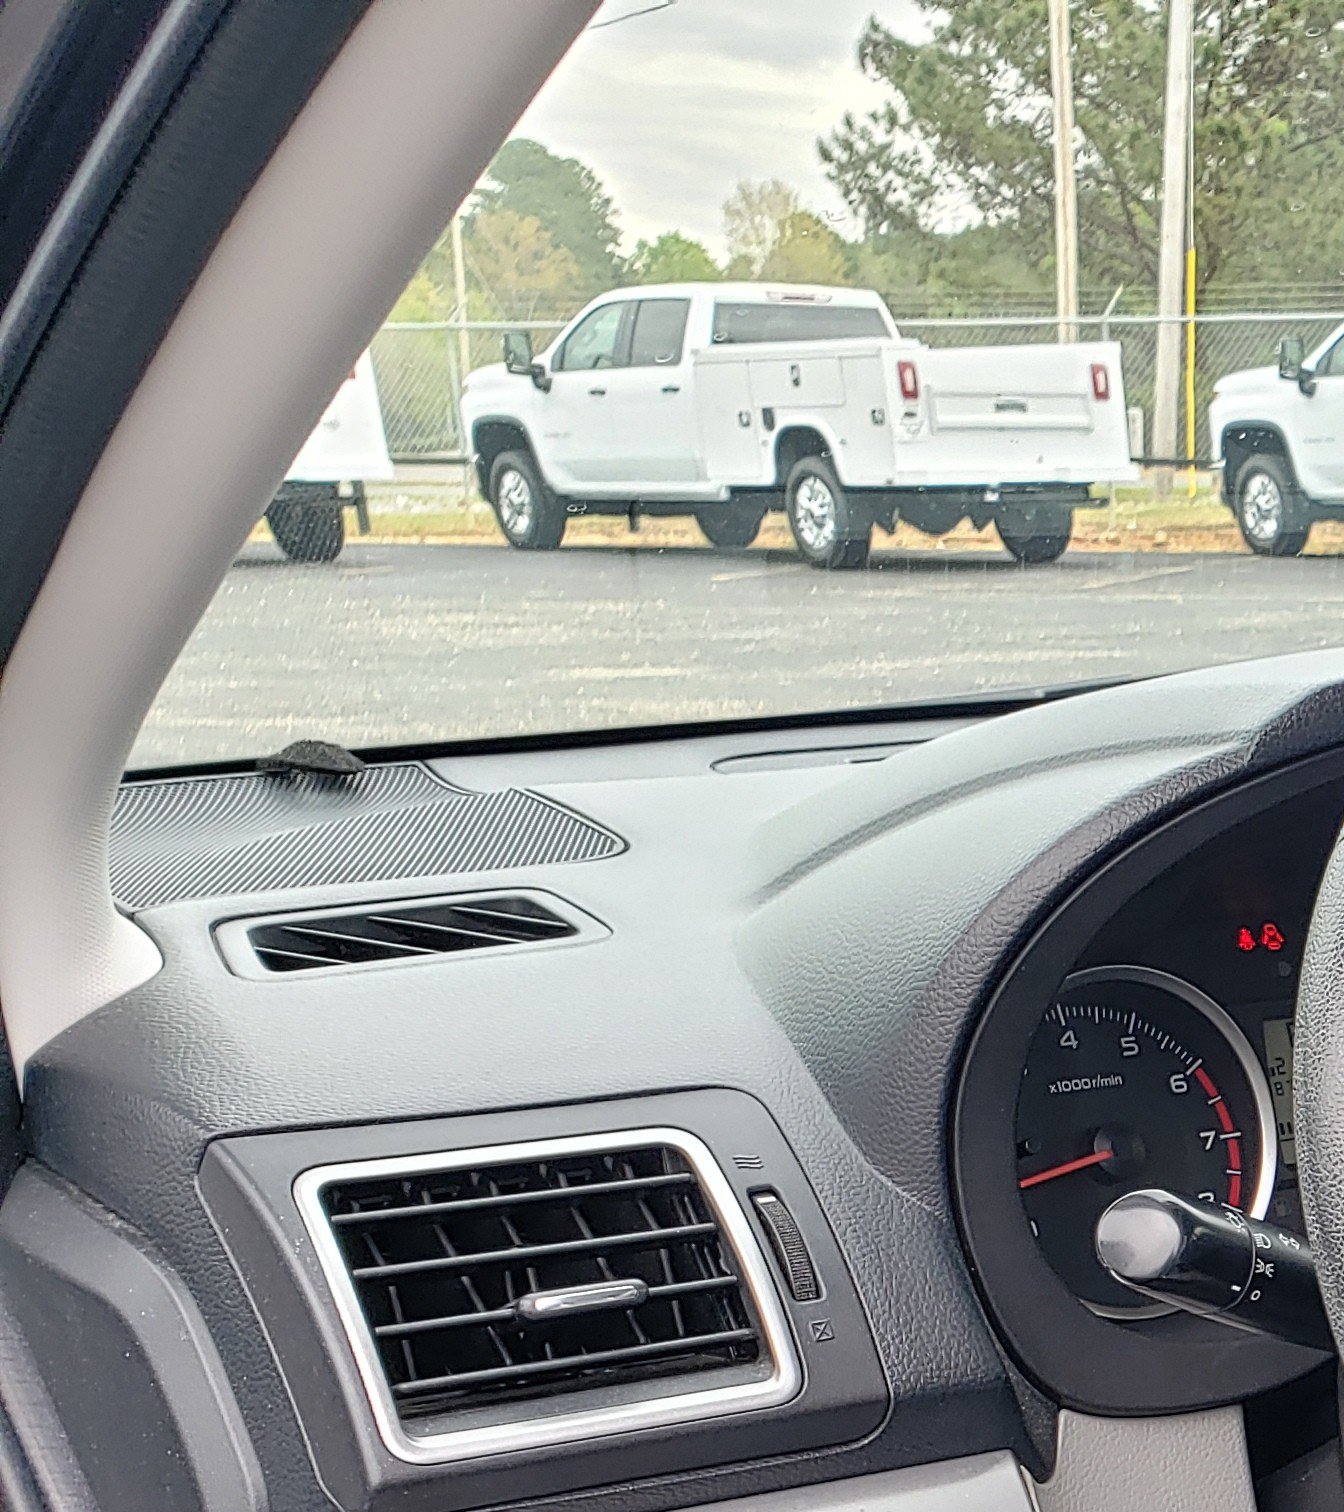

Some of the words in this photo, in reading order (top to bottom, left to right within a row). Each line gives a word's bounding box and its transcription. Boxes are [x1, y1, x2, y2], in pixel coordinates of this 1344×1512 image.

[1059, 1029, 1078, 1049] 4
[1120, 1036, 1139, 1056] 5
[1169, 1073, 1188, 1093] 6
[1200, 1131, 1216, 1150] 7
